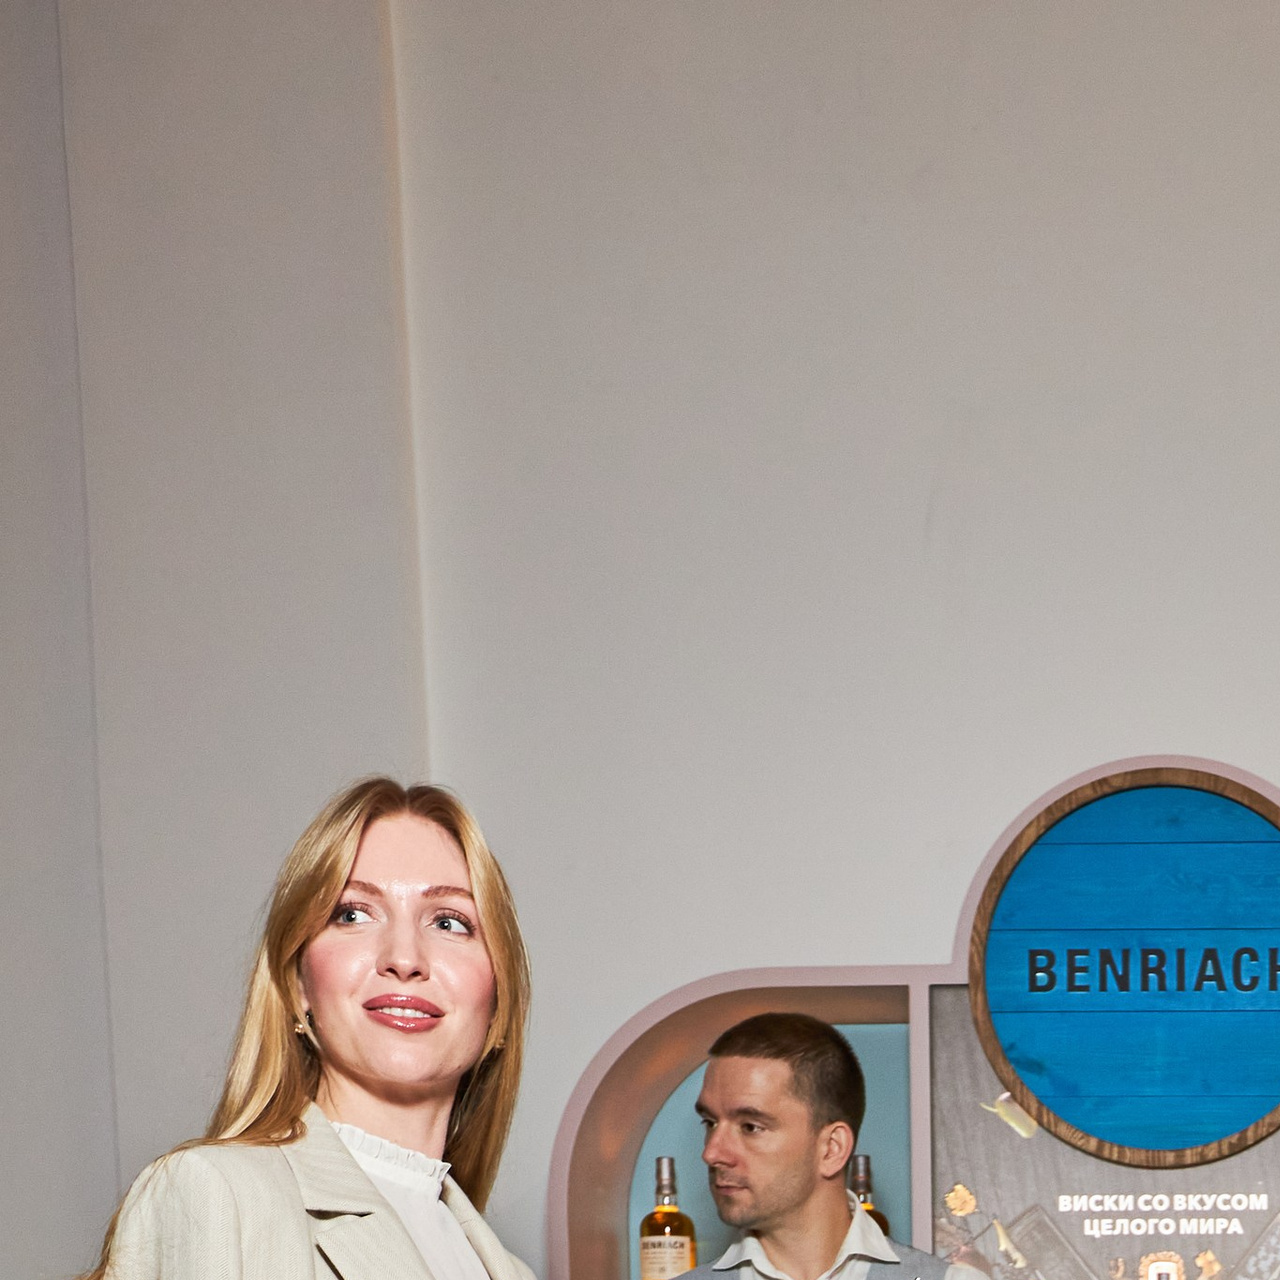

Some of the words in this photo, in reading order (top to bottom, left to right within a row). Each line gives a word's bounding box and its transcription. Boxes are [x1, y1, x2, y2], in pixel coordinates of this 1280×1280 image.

[1058, 1195, 1135, 1212] ВИСКИ
[1137, 1194, 1170, 1211] СО
[1173, 1193, 1269, 1211] ВКУСОМ
[1084, 1218, 1176, 1238] ЦЕЛОГО
[1179, 1218, 1244, 1235] МИРА
